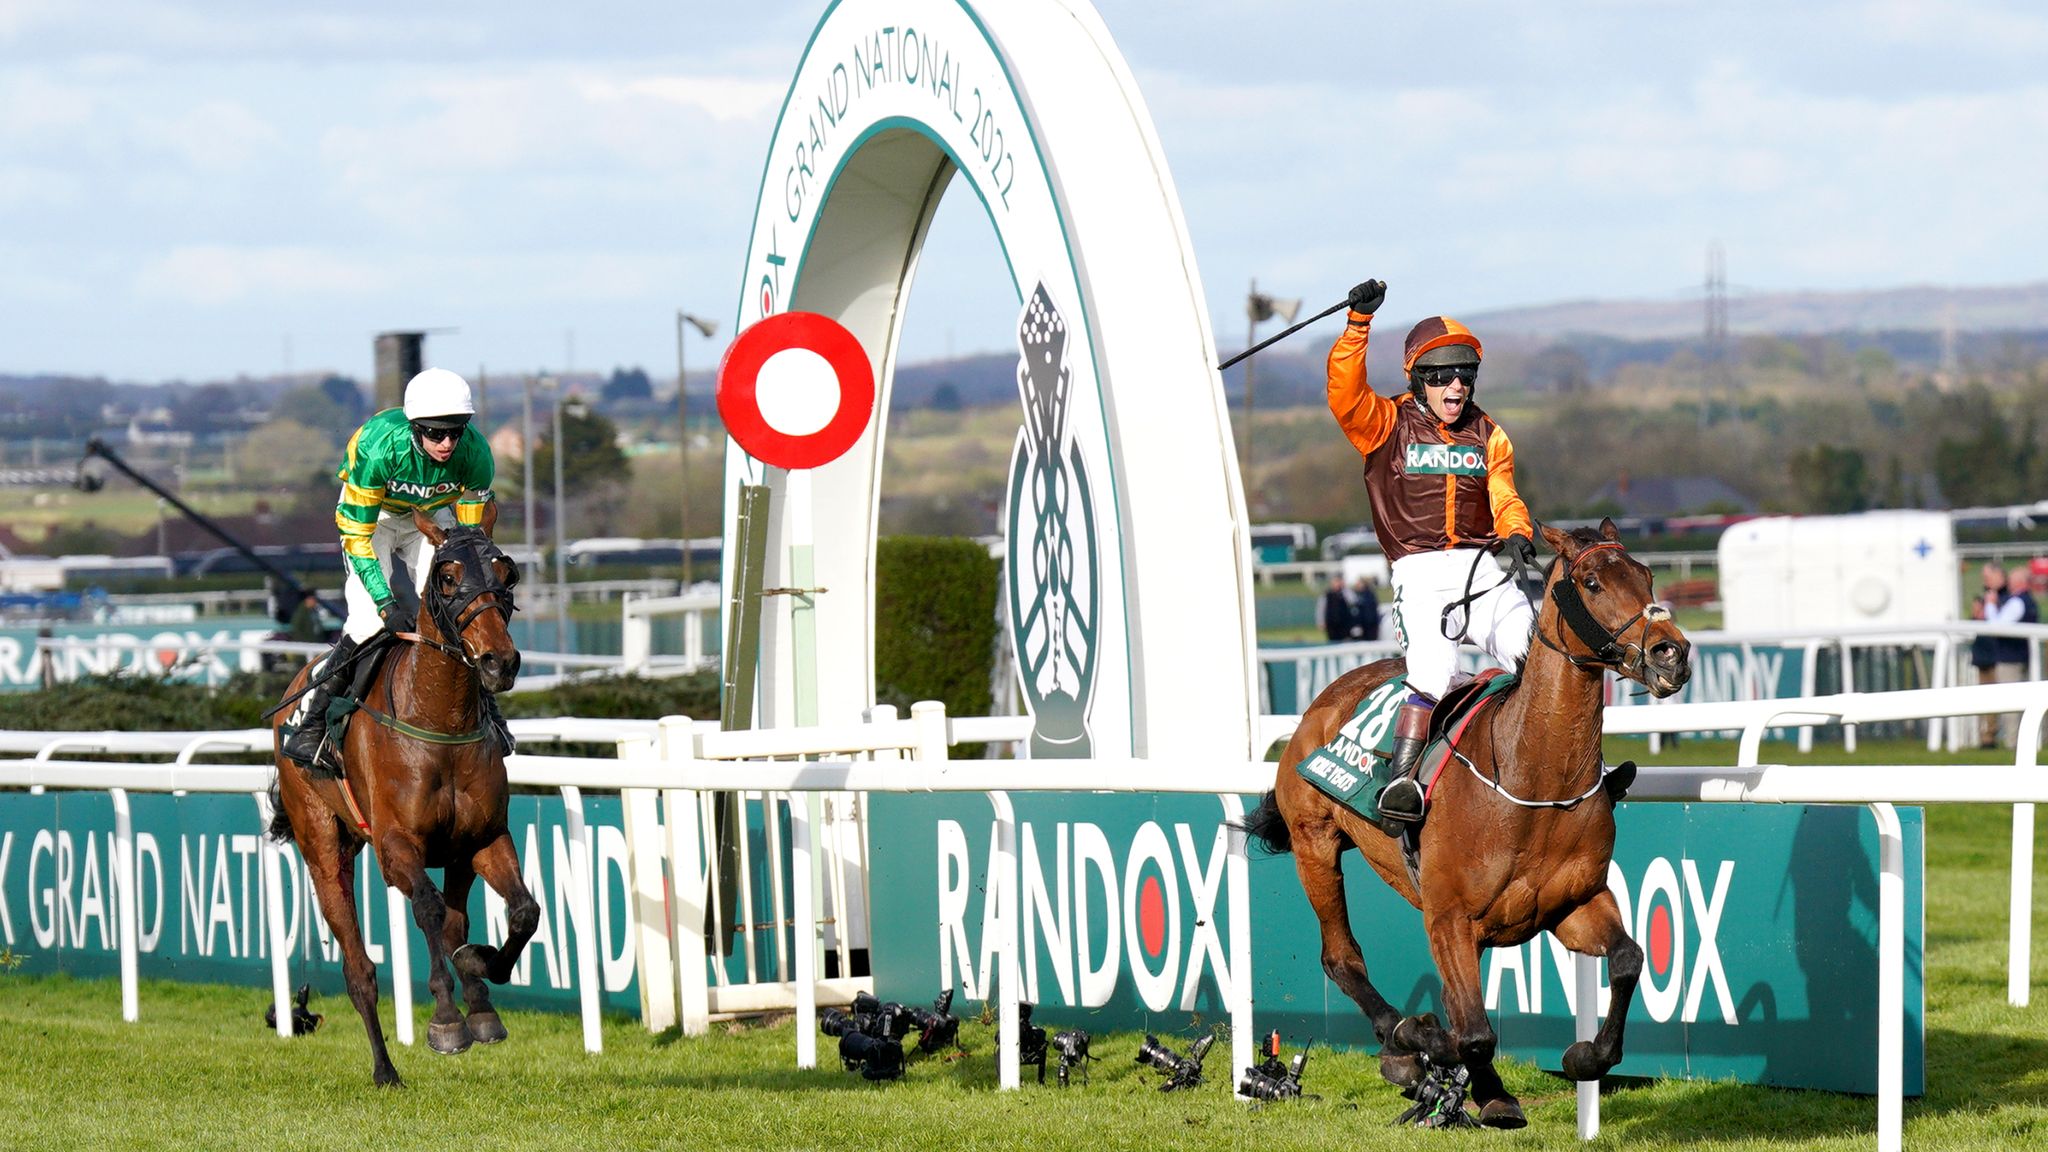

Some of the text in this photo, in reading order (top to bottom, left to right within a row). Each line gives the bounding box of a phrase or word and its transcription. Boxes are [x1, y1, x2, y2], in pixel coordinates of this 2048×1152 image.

[785, 26, 1014, 223] GRAND NATIONAL 2022
[386, 480, 461, 499] RANDOX
[1407, 451, 1487, 470] RANDOX
[1340, 683, 1411, 750] 28
[181, 833, 384, 964] NATIONL
